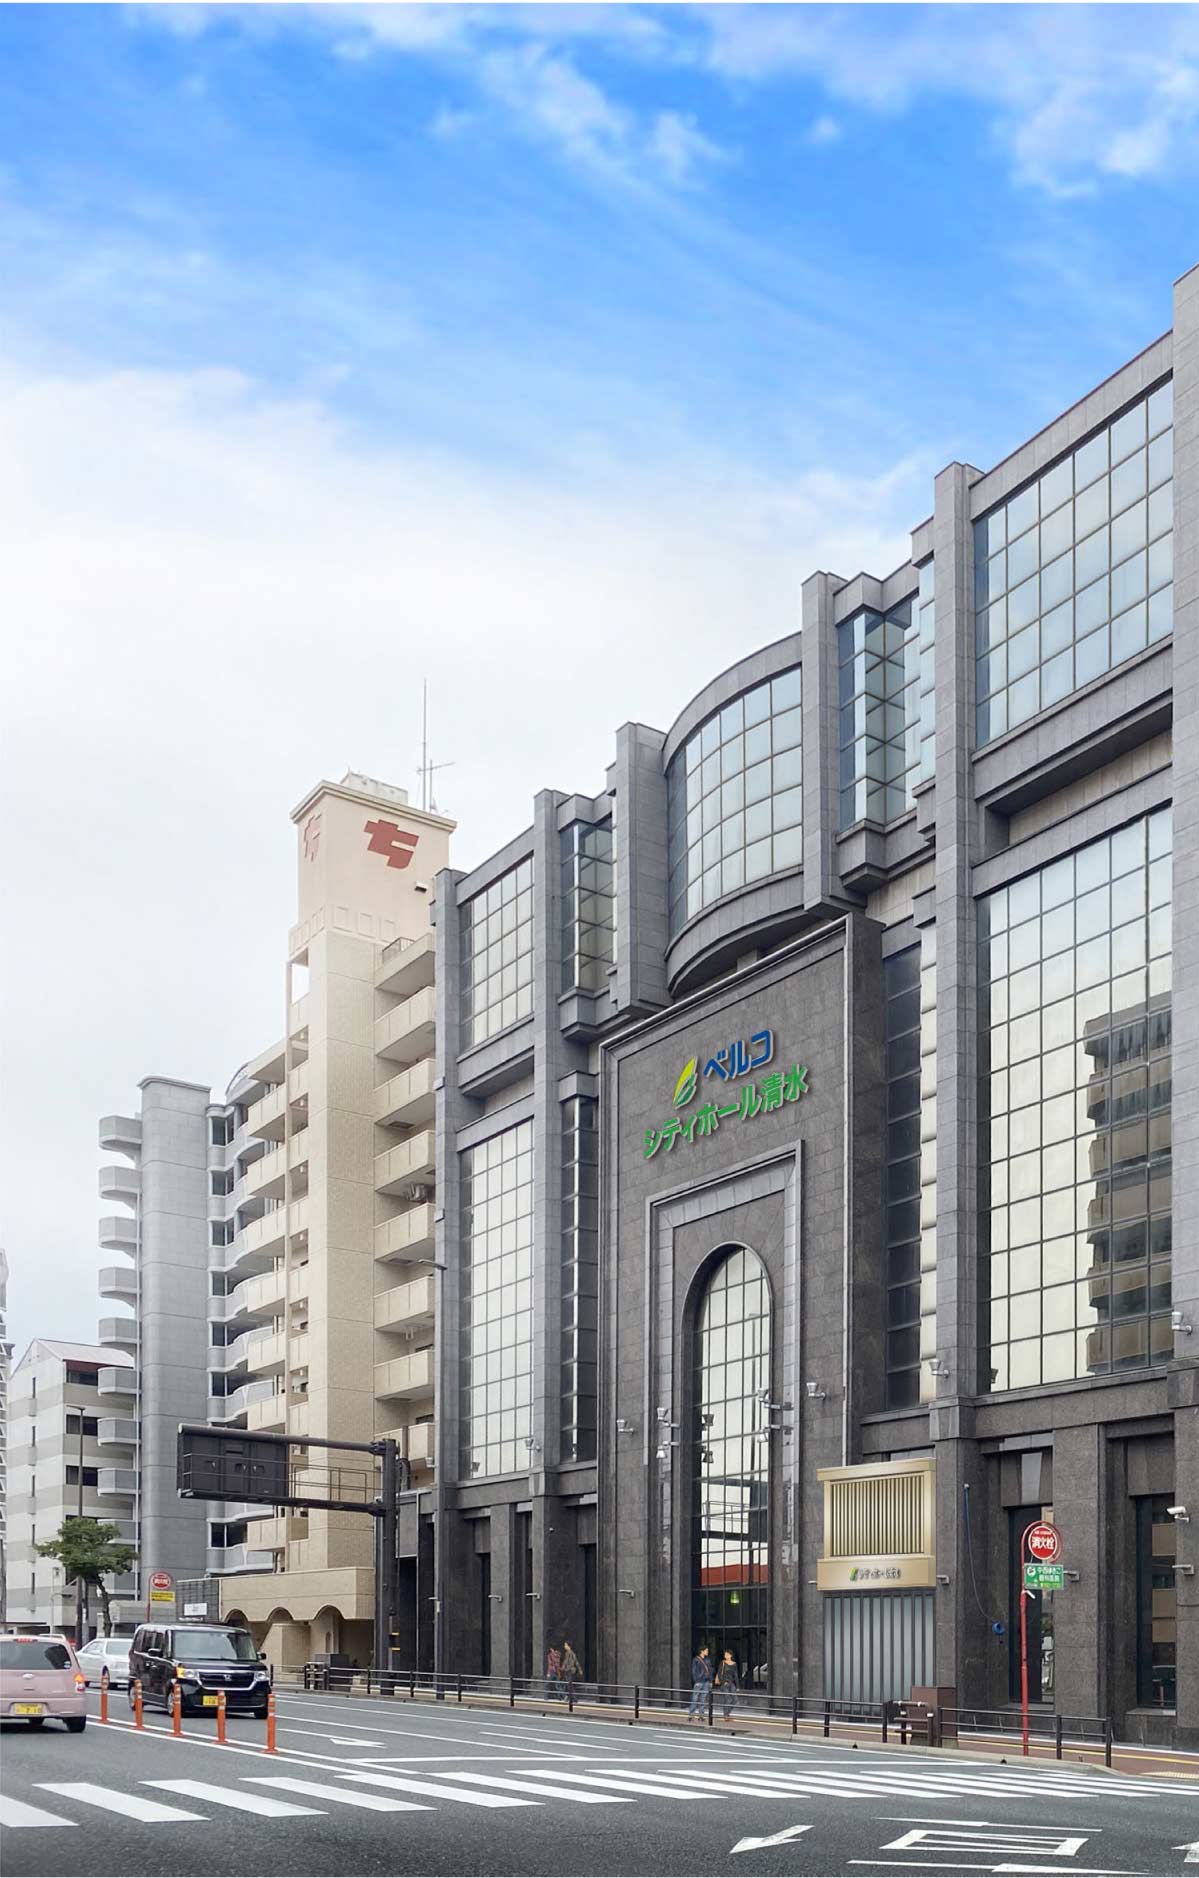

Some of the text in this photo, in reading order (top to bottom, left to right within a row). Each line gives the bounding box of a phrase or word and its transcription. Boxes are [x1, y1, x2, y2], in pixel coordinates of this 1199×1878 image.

[703, 1029, 773, 1082] ベルコ
[643, 1063, 809, 1159] シティホール清水
[1031, 1536, 1055, 1550] 消火栓
